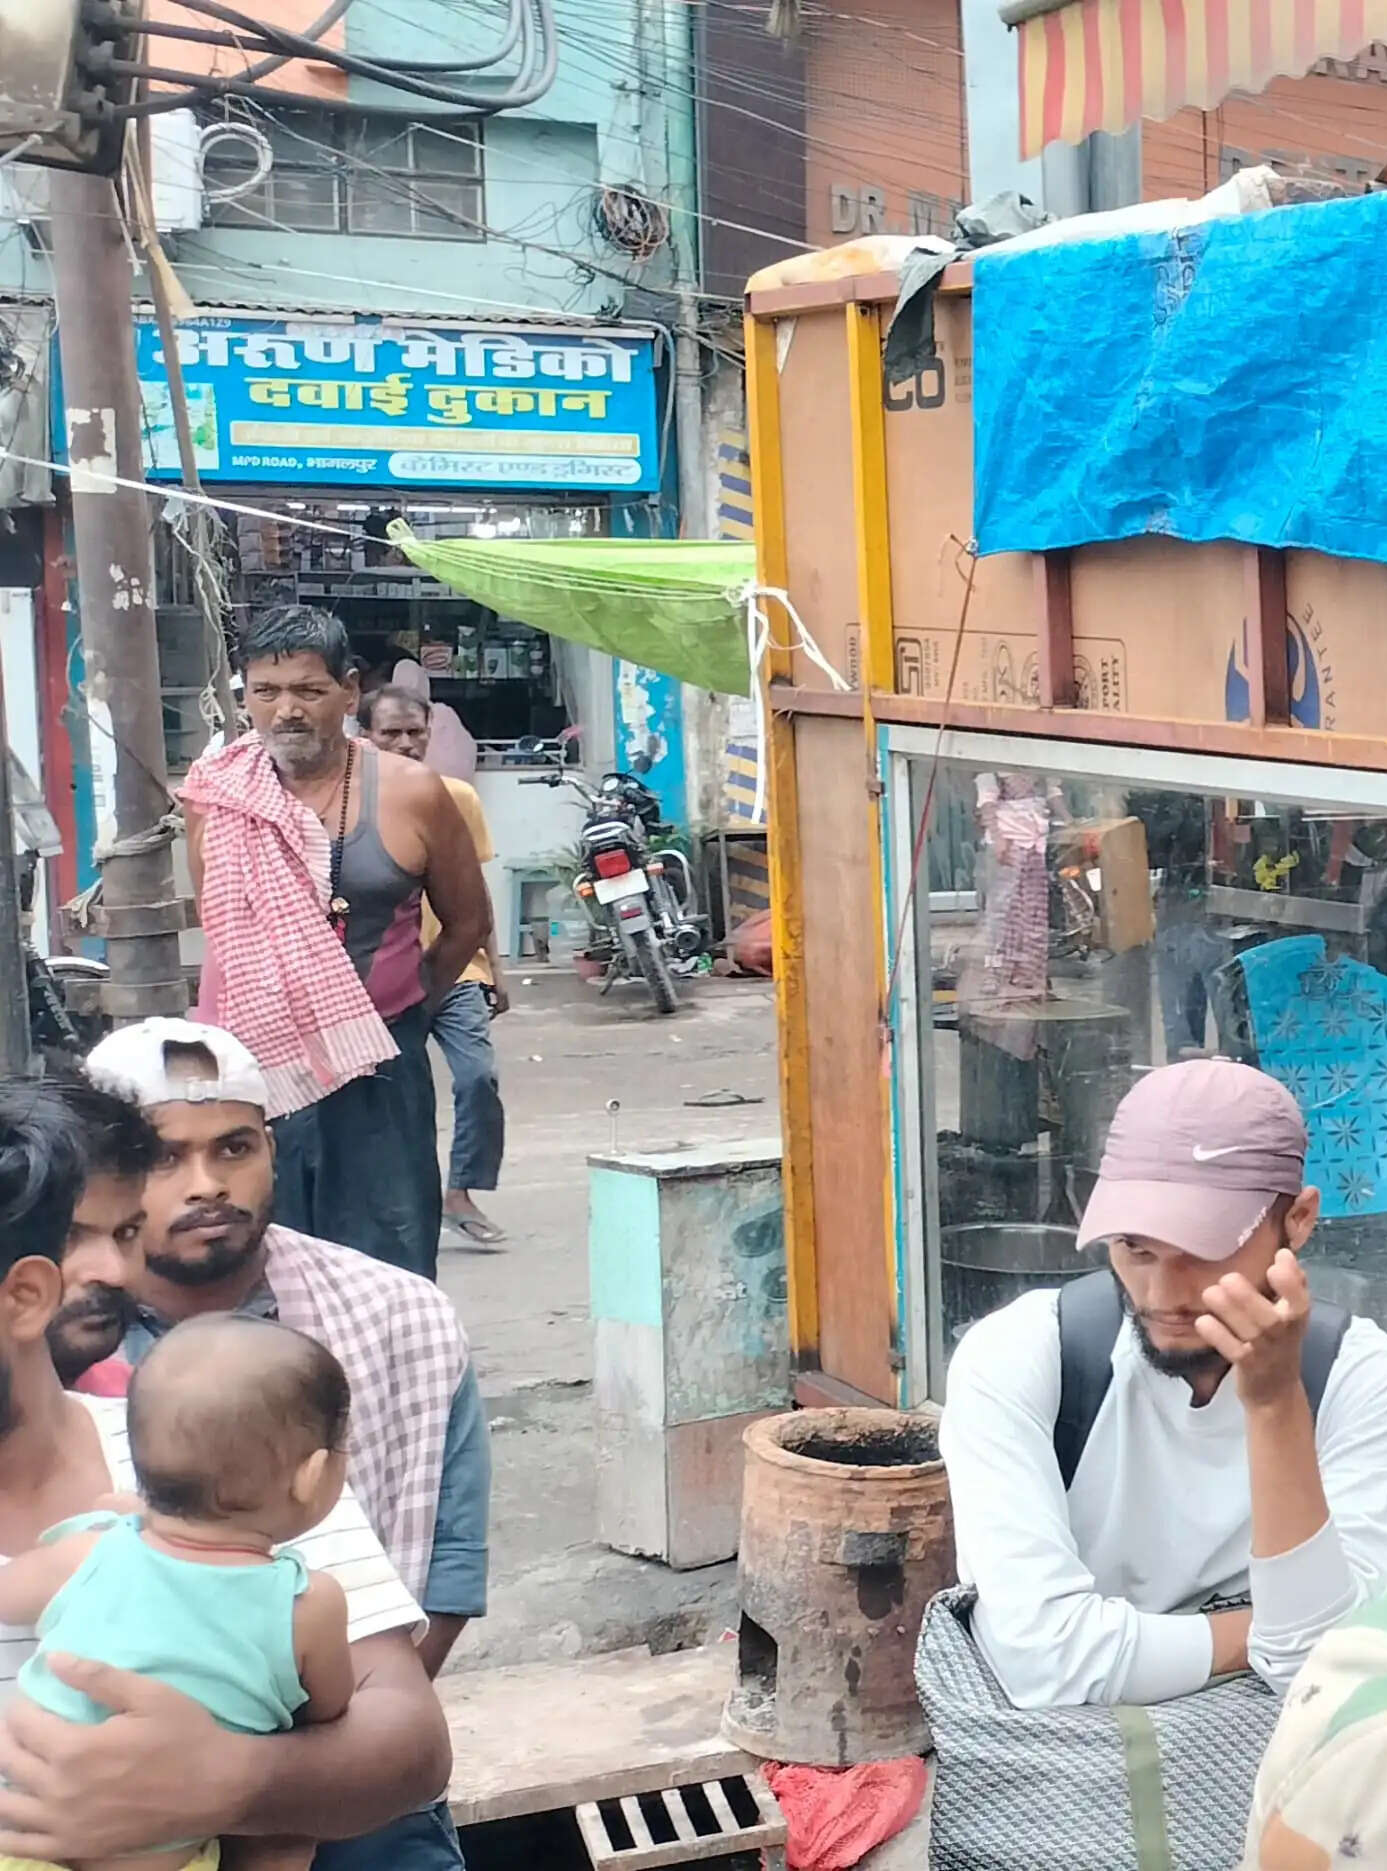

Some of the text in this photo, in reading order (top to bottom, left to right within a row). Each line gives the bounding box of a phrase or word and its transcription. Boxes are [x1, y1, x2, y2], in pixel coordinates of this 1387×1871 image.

[398, 329, 638, 383] मेडिको
[243, 372, 612, 424] दवाई दुकान
